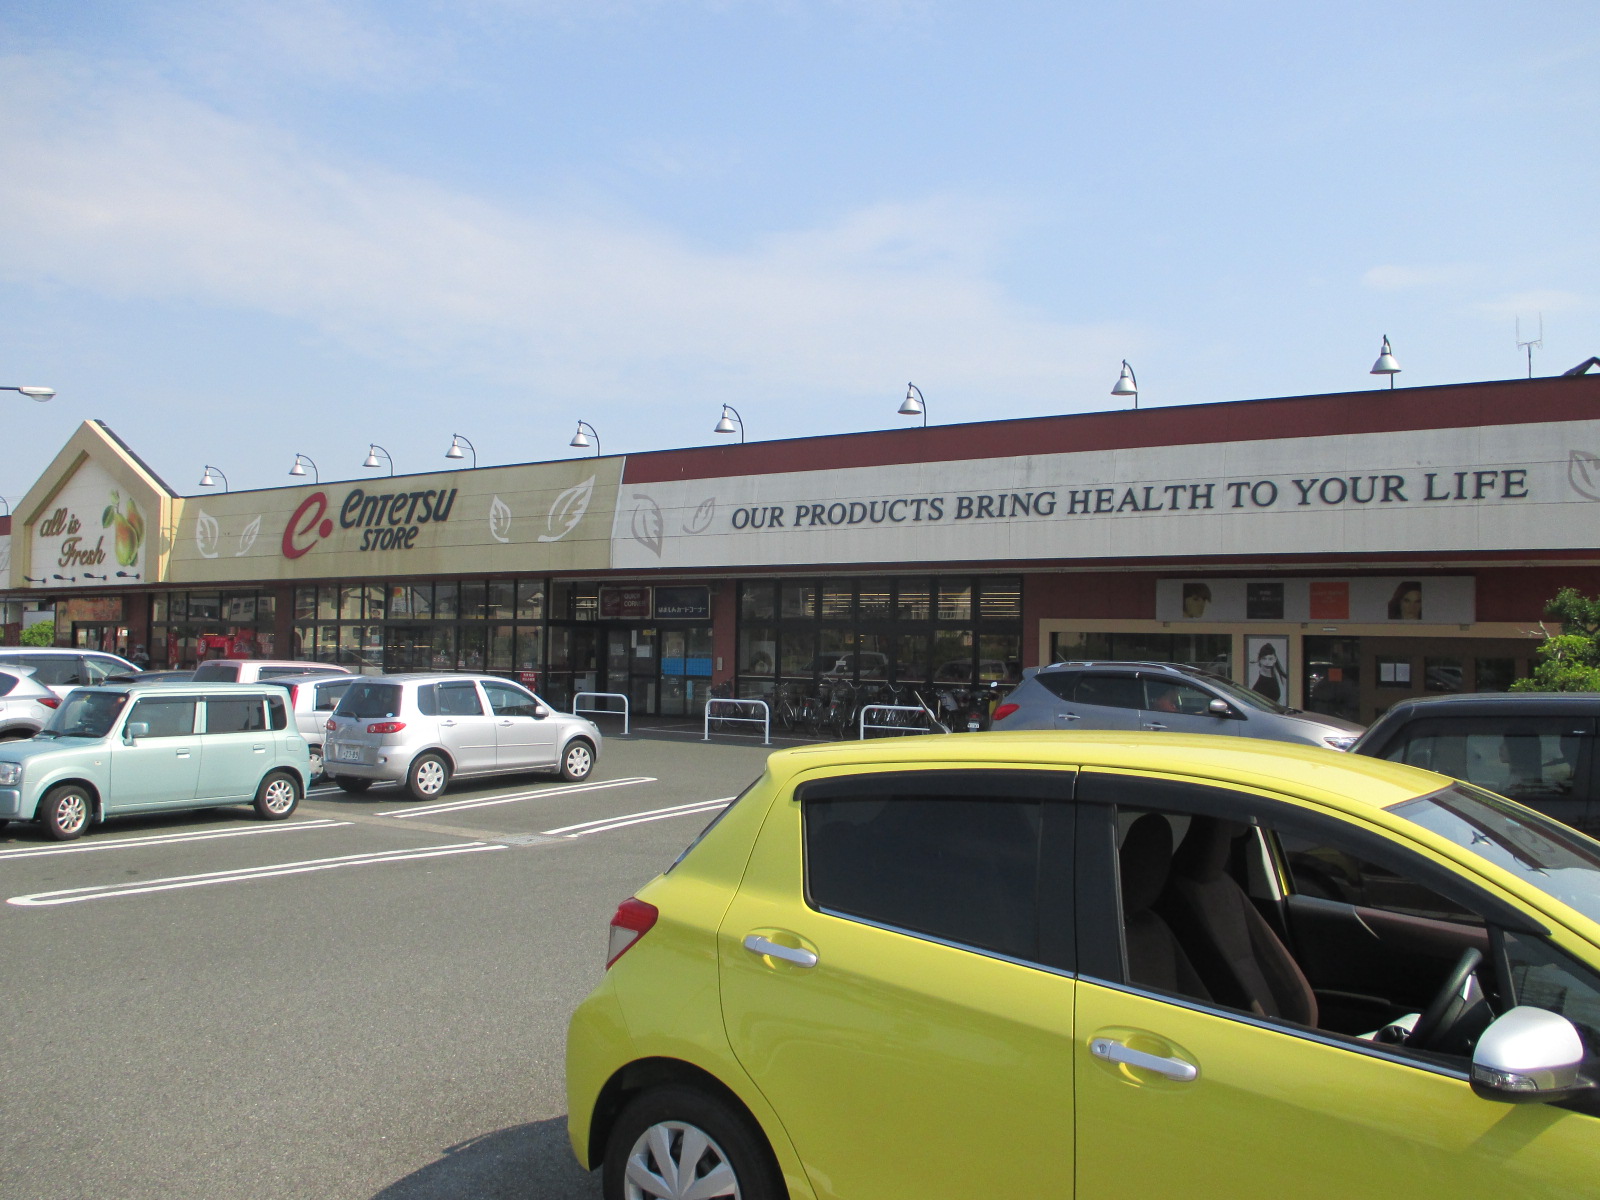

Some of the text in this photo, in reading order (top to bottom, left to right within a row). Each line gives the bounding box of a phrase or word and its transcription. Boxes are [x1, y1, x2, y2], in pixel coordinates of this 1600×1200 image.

[732, 470, 1529, 529] OUR PRODUCTS BRING HEALTH TO YOUR LIFE
[40, 507, 81, 537] all is
[58, 535, 106, 567] Fresh
